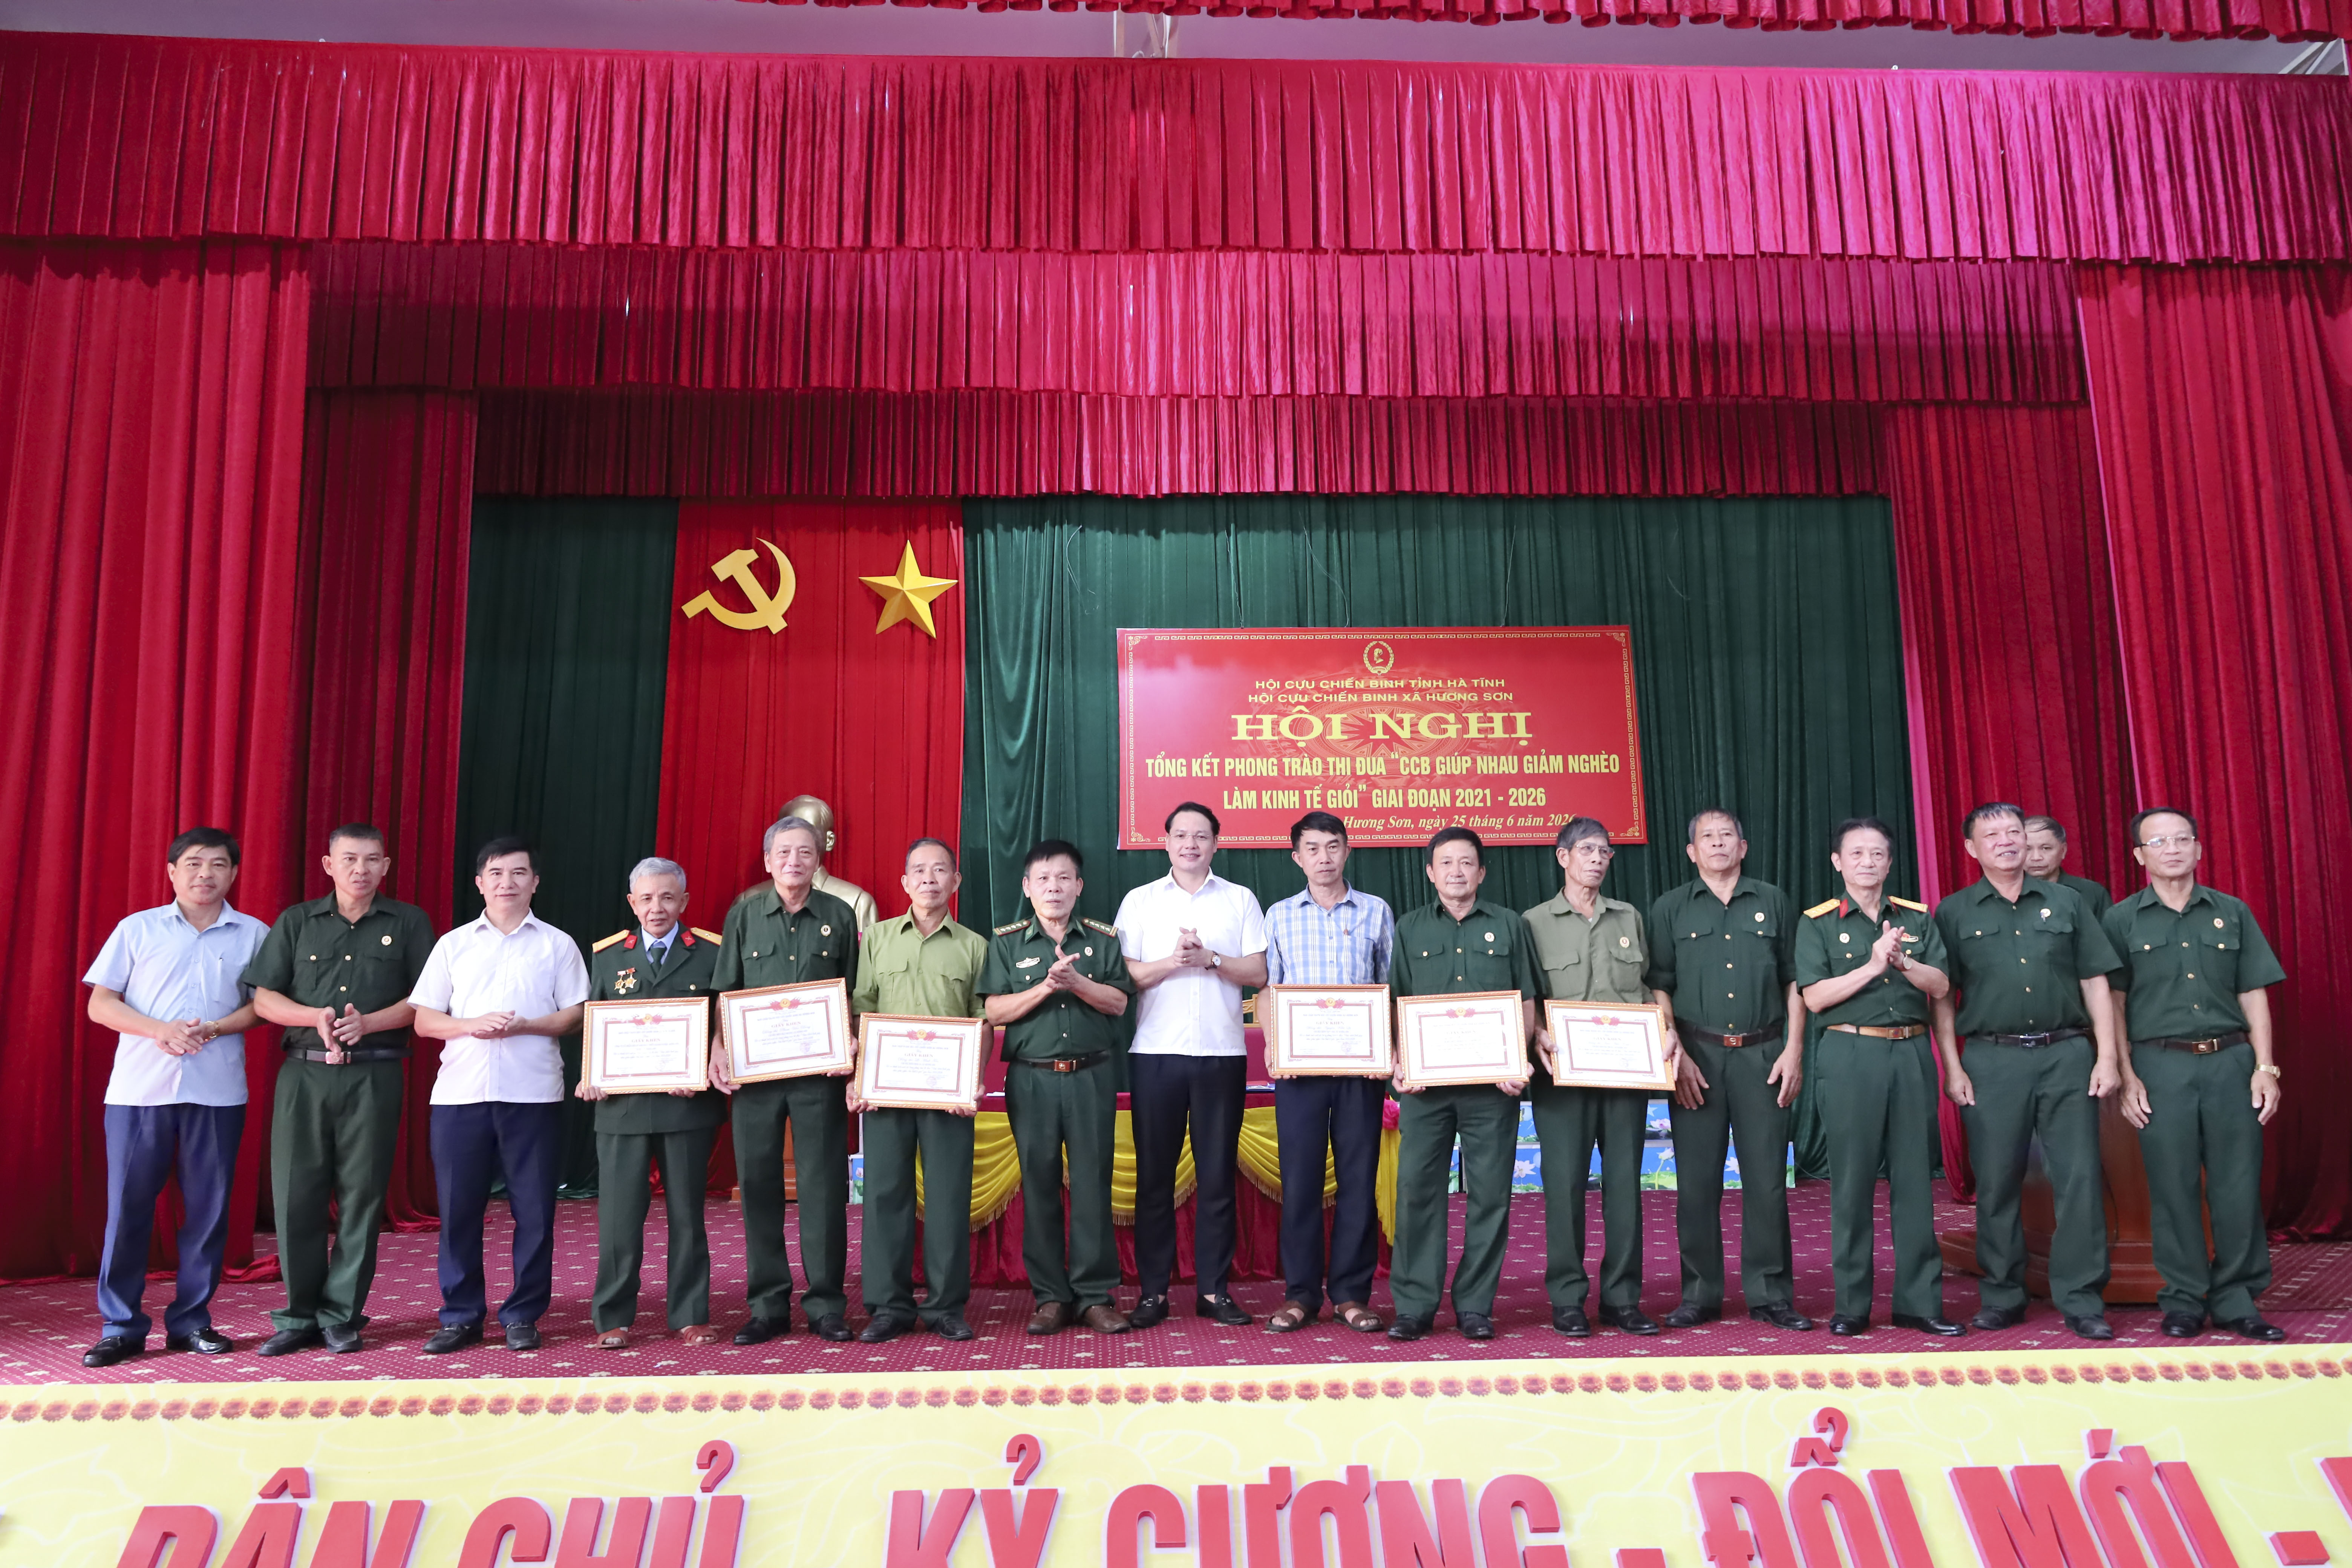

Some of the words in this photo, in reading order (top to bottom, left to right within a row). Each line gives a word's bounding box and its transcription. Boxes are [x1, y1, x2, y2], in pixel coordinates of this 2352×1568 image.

[1248, 692, 1272, 704] HỘI
[1278, 693, 1308, 704] CỰU
[1312, 691, 1357, 702] CHIẾN
[1402, 692, 1421, 701] XÃ
[1426, 692, 1478, 701] HƯƠNG
[1483, 692, 1513, 701] SƠN
[1256, 679, 1280, 690] HỘI
[1285, 680, 1315, 690] CỰU
[1320, 677, 1365, 689] CHIẾN
[1370, 680, 1404, 688] BINH
[1409, 677, 1442, 688] TỈNH
[1447, 678, 1467, 687] HÀ
[1472, 677, 1505, 687] TĨNH
[1231, 705, 1348, 747] HỘI
[1369, 712, 1533, 746] NGHỊ
[1145, 751, 1187, 777] TỔNG
[1191, 752, 1220, 777] KẾT
[1225, 758, 1278, 777] PHONG
[1282, 754, 1322, 776] TRÀO
[1326, 757, 1351, 776] THI
[1356, 756, 1387, 775] ĐUA
[1435, 753, 1472, 775] GIÚP
[1477, 755, 1518, 774] NHAU
[1523, 749, 1563, 773] GIẢM
[1568, 750, 1620, 773] NGHÈO
[1223, 787, 1257, 809] LÀM
[1262, 790, 1299, 809] KINH
[1304, 783, 1322, 808] TẾ
[1372, 789, 1403, 808] GIAI
[1408, 788, 1451, 812] ĐOẠN
[1455, 788, 1491, 807] 2021
[1508, 787, 1546, 806] 2026
[1343, 816, 1385, 831] Hương
[1387, 816, 1414, 830] Sơn,
[1418, 815, 1448, 830] ngày
[1450, 815, 1467, 827] 25
[1468, 815, 1504, 830] tháng
[1507, 815, 1515, 826] 6
[1516, 814, 1544, 826] năm
[1692, 1407, 1935, 1568] ĐỔI
[1948, 1429, 2239, 1568] MỚI
